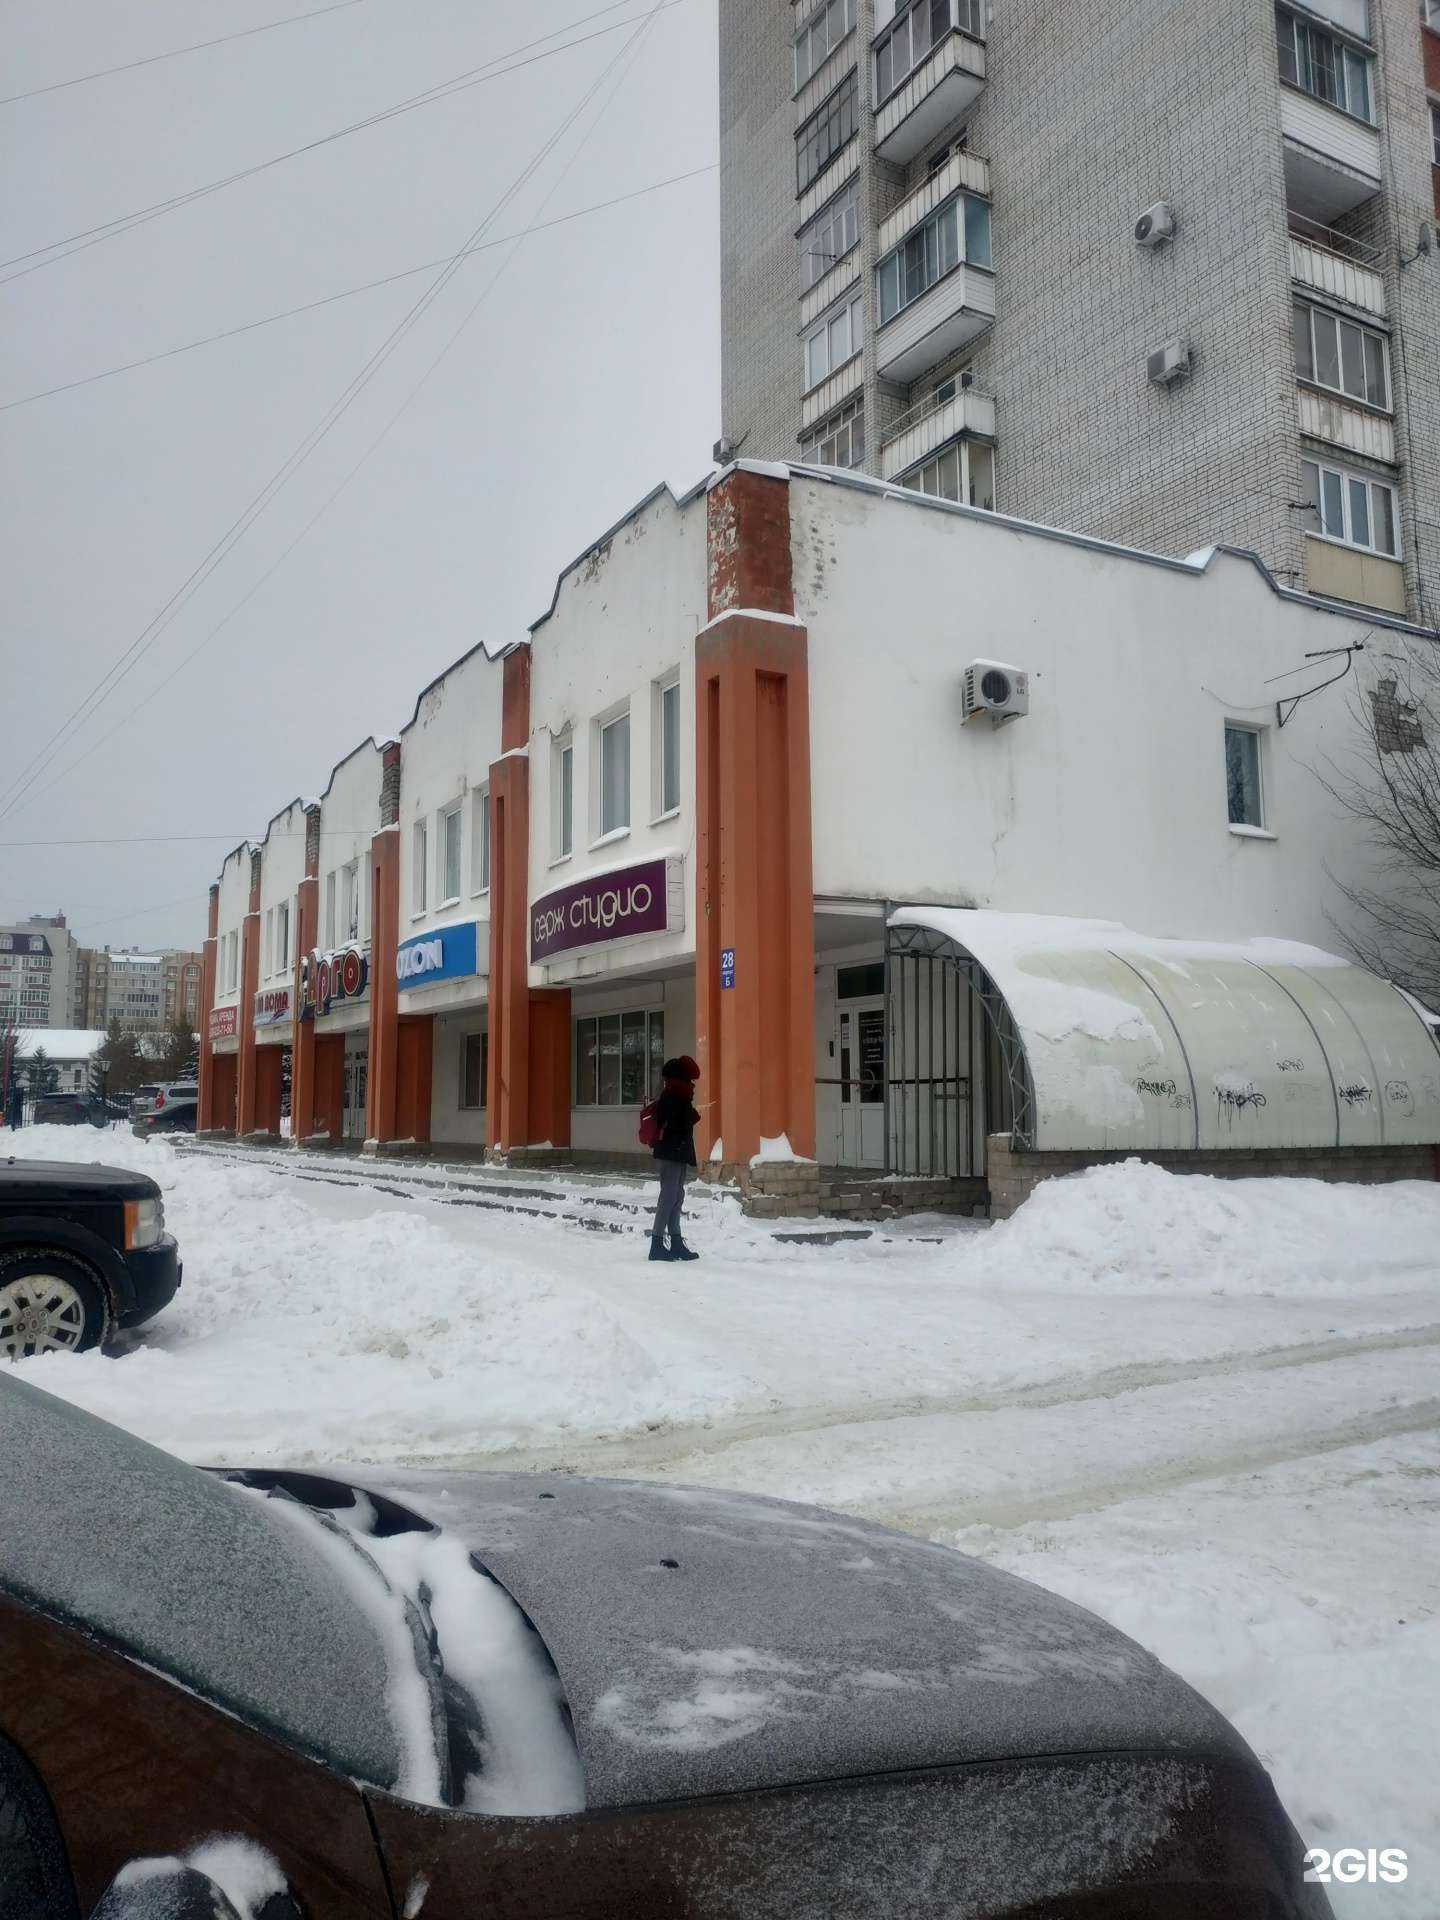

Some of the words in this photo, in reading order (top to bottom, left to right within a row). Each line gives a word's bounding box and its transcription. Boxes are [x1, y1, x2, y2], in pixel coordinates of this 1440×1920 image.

[534, 905, 566, 945] серж
[569, 883, 653, 929] студио
[722, 951, 734, 969] 28
